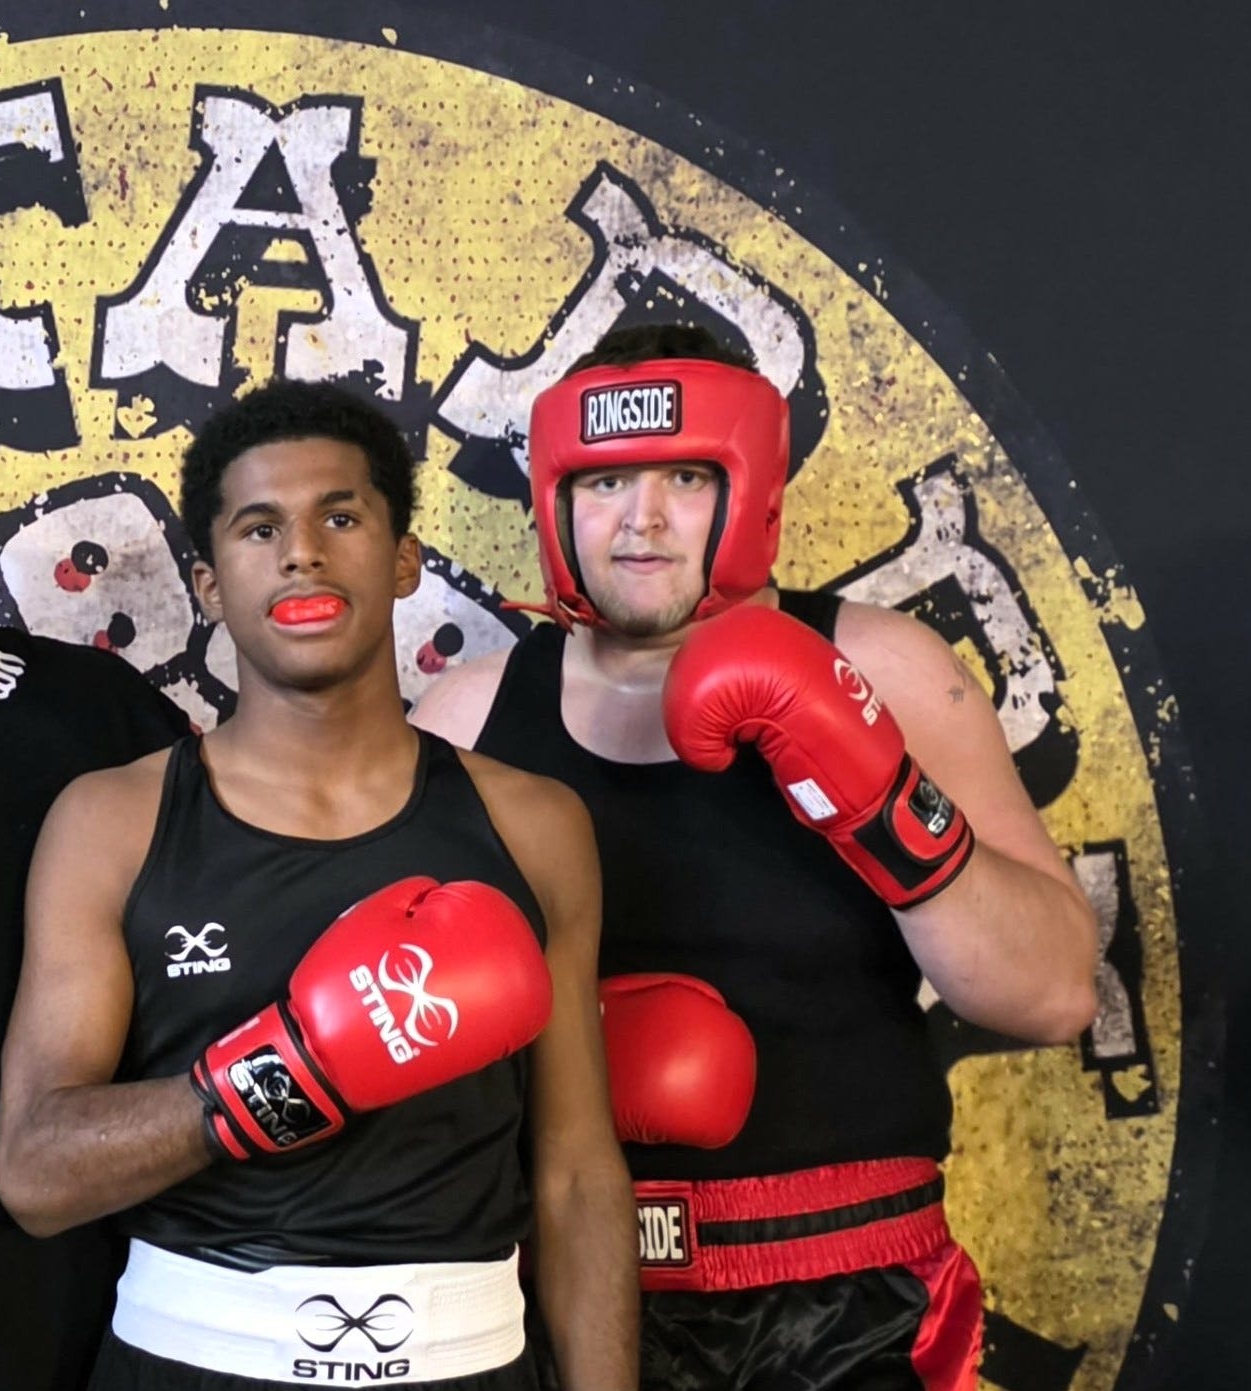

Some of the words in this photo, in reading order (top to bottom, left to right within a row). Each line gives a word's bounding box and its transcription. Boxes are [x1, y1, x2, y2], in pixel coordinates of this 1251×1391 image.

[587, 386, 674, 437] RINGSIDE
[166, 957, 232, 978] STING
[348, 964, 415, 1065] STING
[292, 1357, 411, 1381] STING
